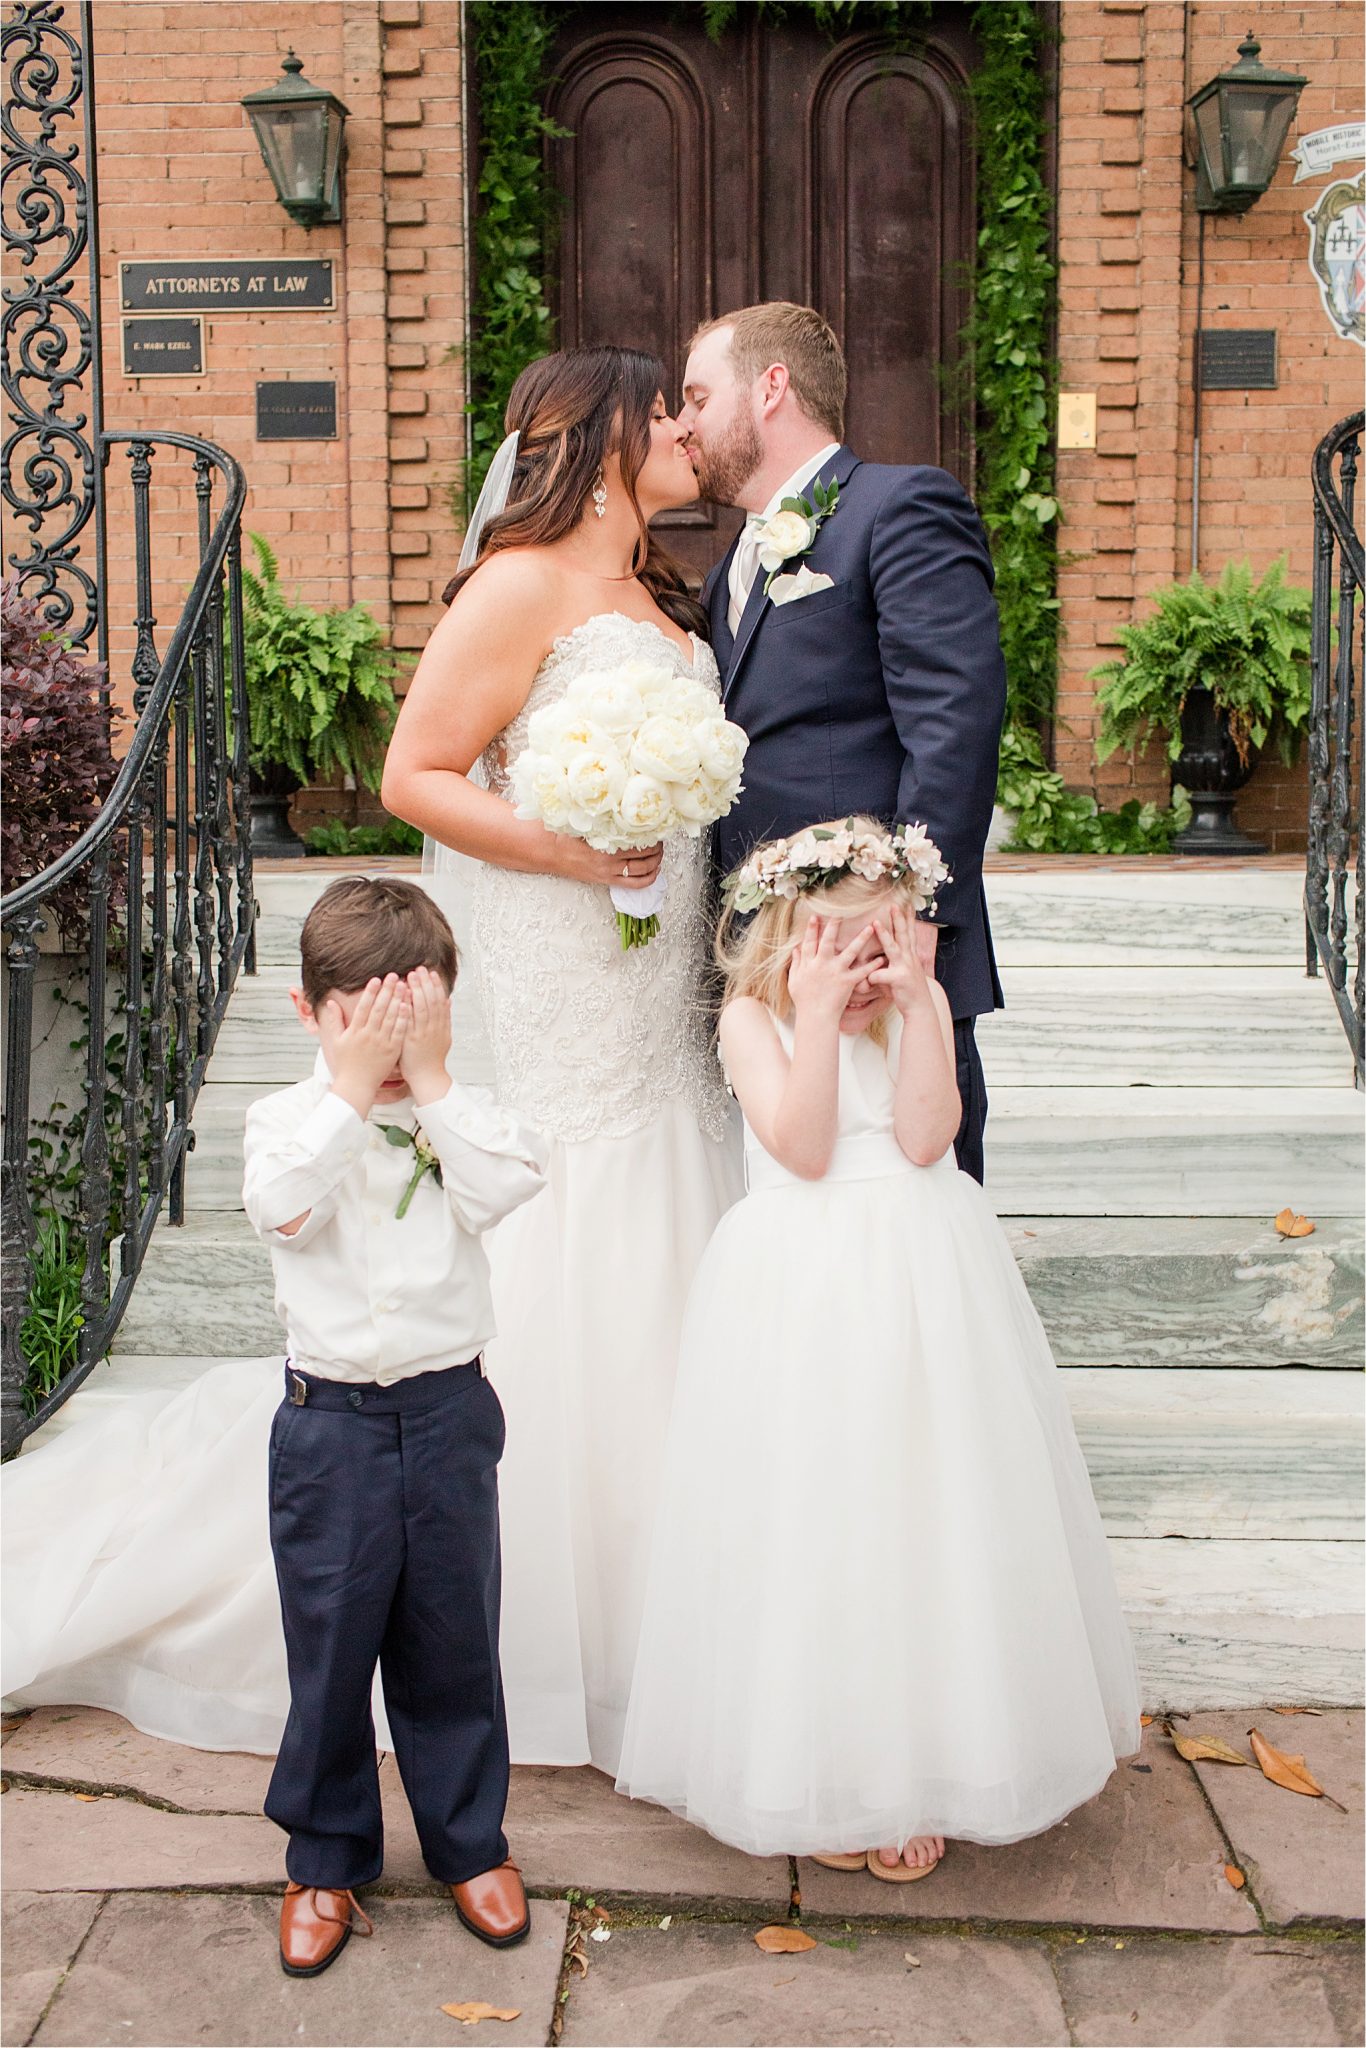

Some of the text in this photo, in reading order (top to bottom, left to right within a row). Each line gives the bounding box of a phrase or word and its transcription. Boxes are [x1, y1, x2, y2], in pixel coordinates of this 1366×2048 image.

[1305, 128, 1361, 148] MOBILE HISTORIC
[145, 276, 309, 295] ATTORNEYS AT LAW
